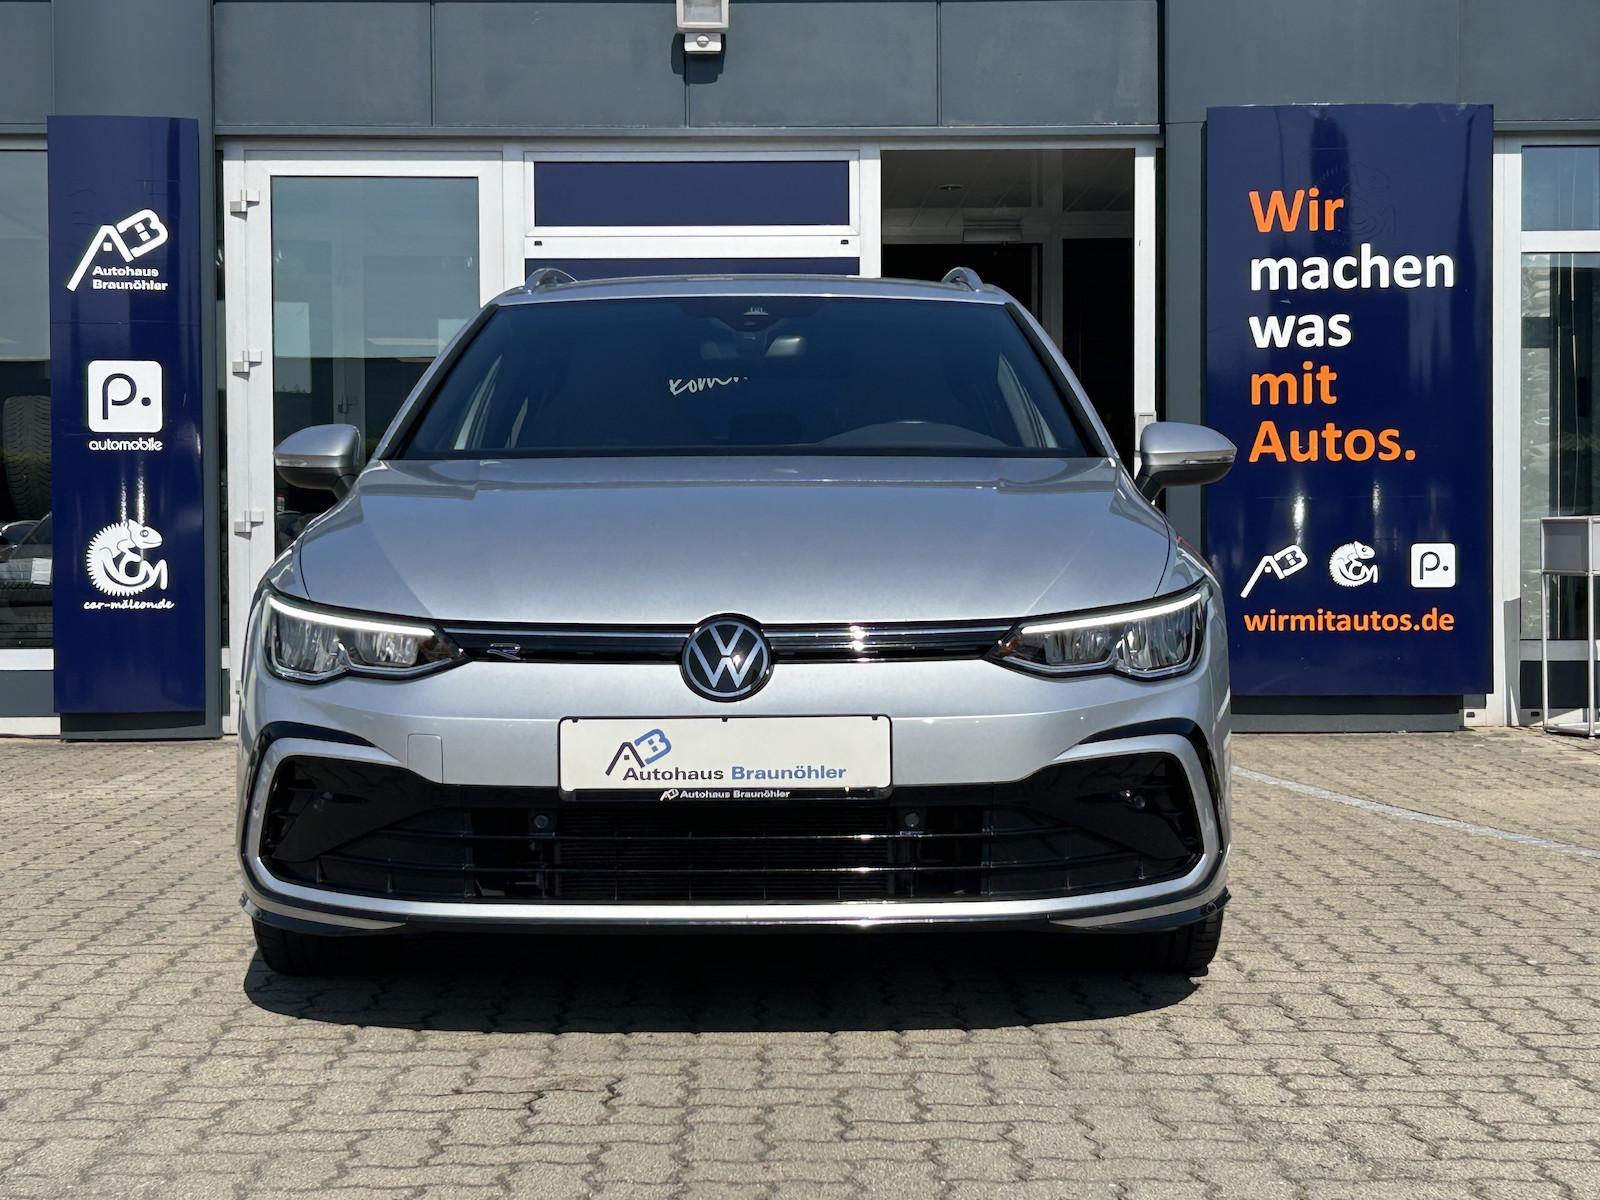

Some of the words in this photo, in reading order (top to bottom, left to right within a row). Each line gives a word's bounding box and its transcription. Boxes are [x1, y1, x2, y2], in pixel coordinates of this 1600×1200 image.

[1249, 187, 1344, 232] Wir
[92, 266, 159, 278] Autohaus
[1251, 243, 1454, 290] machen
[92, 279, 168, 290] Braunöhler
[1249, 314, 1351, 348] was
[1251, 361, 1337, 405] mit
[88, 437, 163, 451] automobile
[1249, 420, 1416, 462] Autos.
[1243, 607, 1455, 631] wirmitautos.de
[622, 766, 724, 782] Autohaus
[731, 765, 848, 780] Braunöhler
[680, 789, 730, 799] Autohaus
[733, 789, 791, 799] Braunöhler
